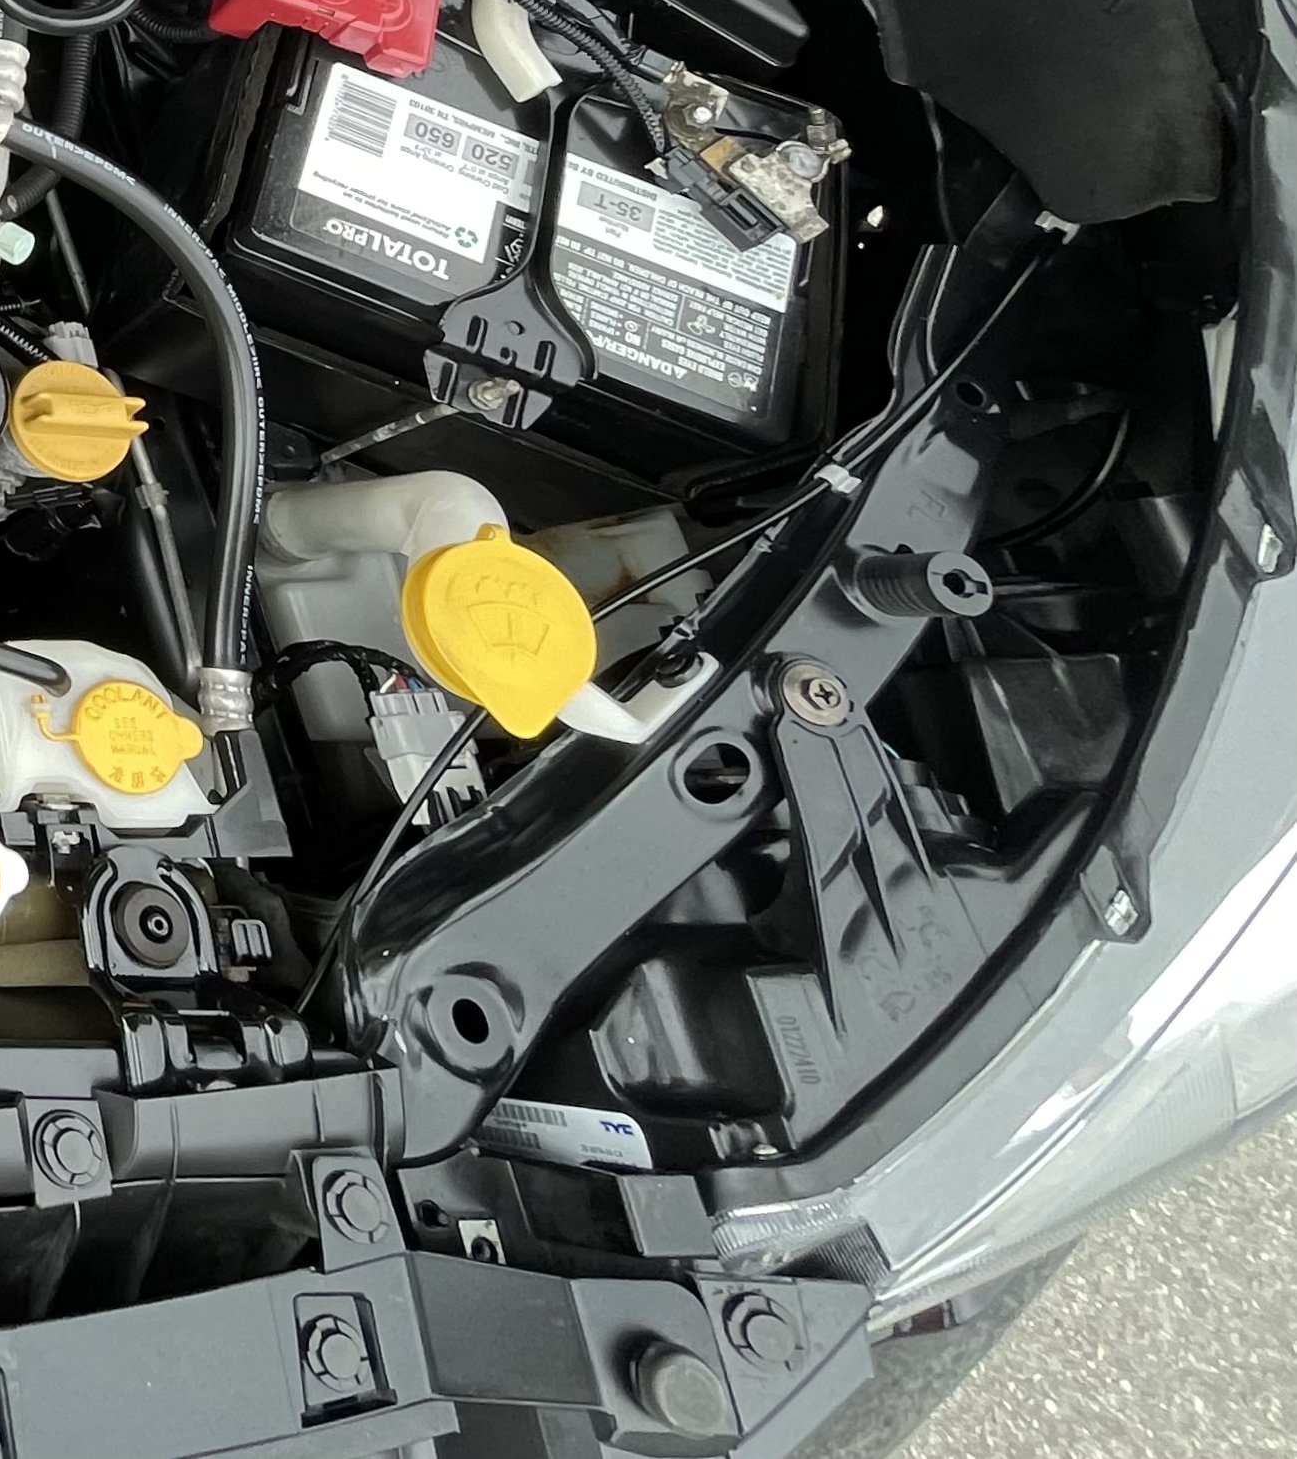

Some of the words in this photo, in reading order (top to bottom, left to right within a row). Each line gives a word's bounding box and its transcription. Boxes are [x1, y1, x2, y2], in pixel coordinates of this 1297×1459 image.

[412, 120, 456, 149] 650
[469, 142, 513, 172] 520
[593, 191, 643, 222] 35-T
[324, 213, 454, 280] TOTALPRO
[84, 685, 169, 721] COOLANT
[598, 1120, 635, 1135] TYC
